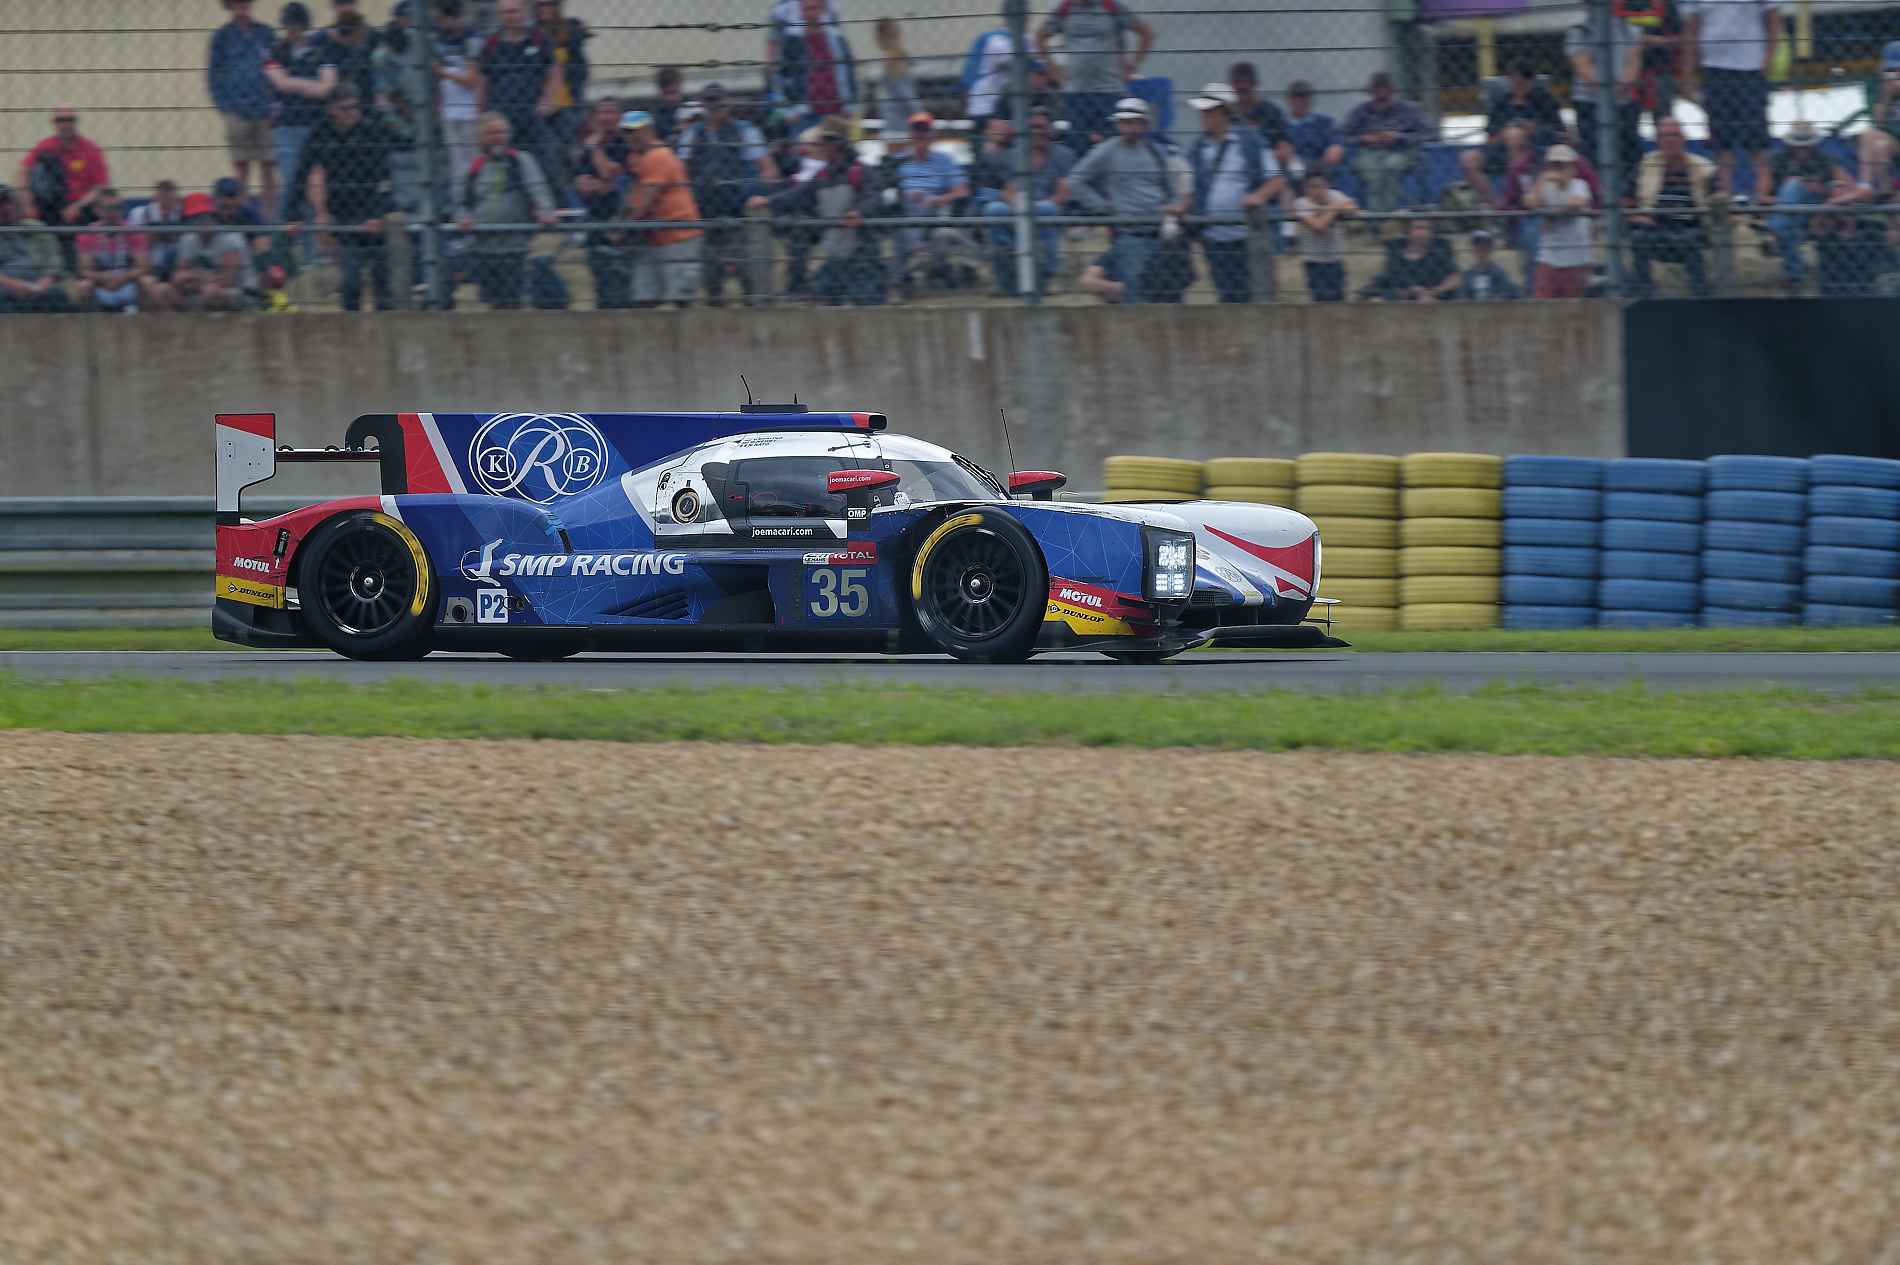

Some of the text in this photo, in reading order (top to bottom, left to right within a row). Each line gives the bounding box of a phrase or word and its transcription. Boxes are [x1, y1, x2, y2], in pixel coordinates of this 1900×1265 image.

[487, 429, 591, 494] K R B
[751, 526, 813, 538] joemacari.com
[233, 556, 270, 573] MOTUL
[499, 553, 688, 576] SMP RACING
[239, 587, 274, 599] DUNLOP
[811, 568, 869, 617] 35
[1060, 588, 1102, 608] MOTUL
[480, 594, 506, 618] P2
[1062, 609, 1105, 622] DUNLOP
